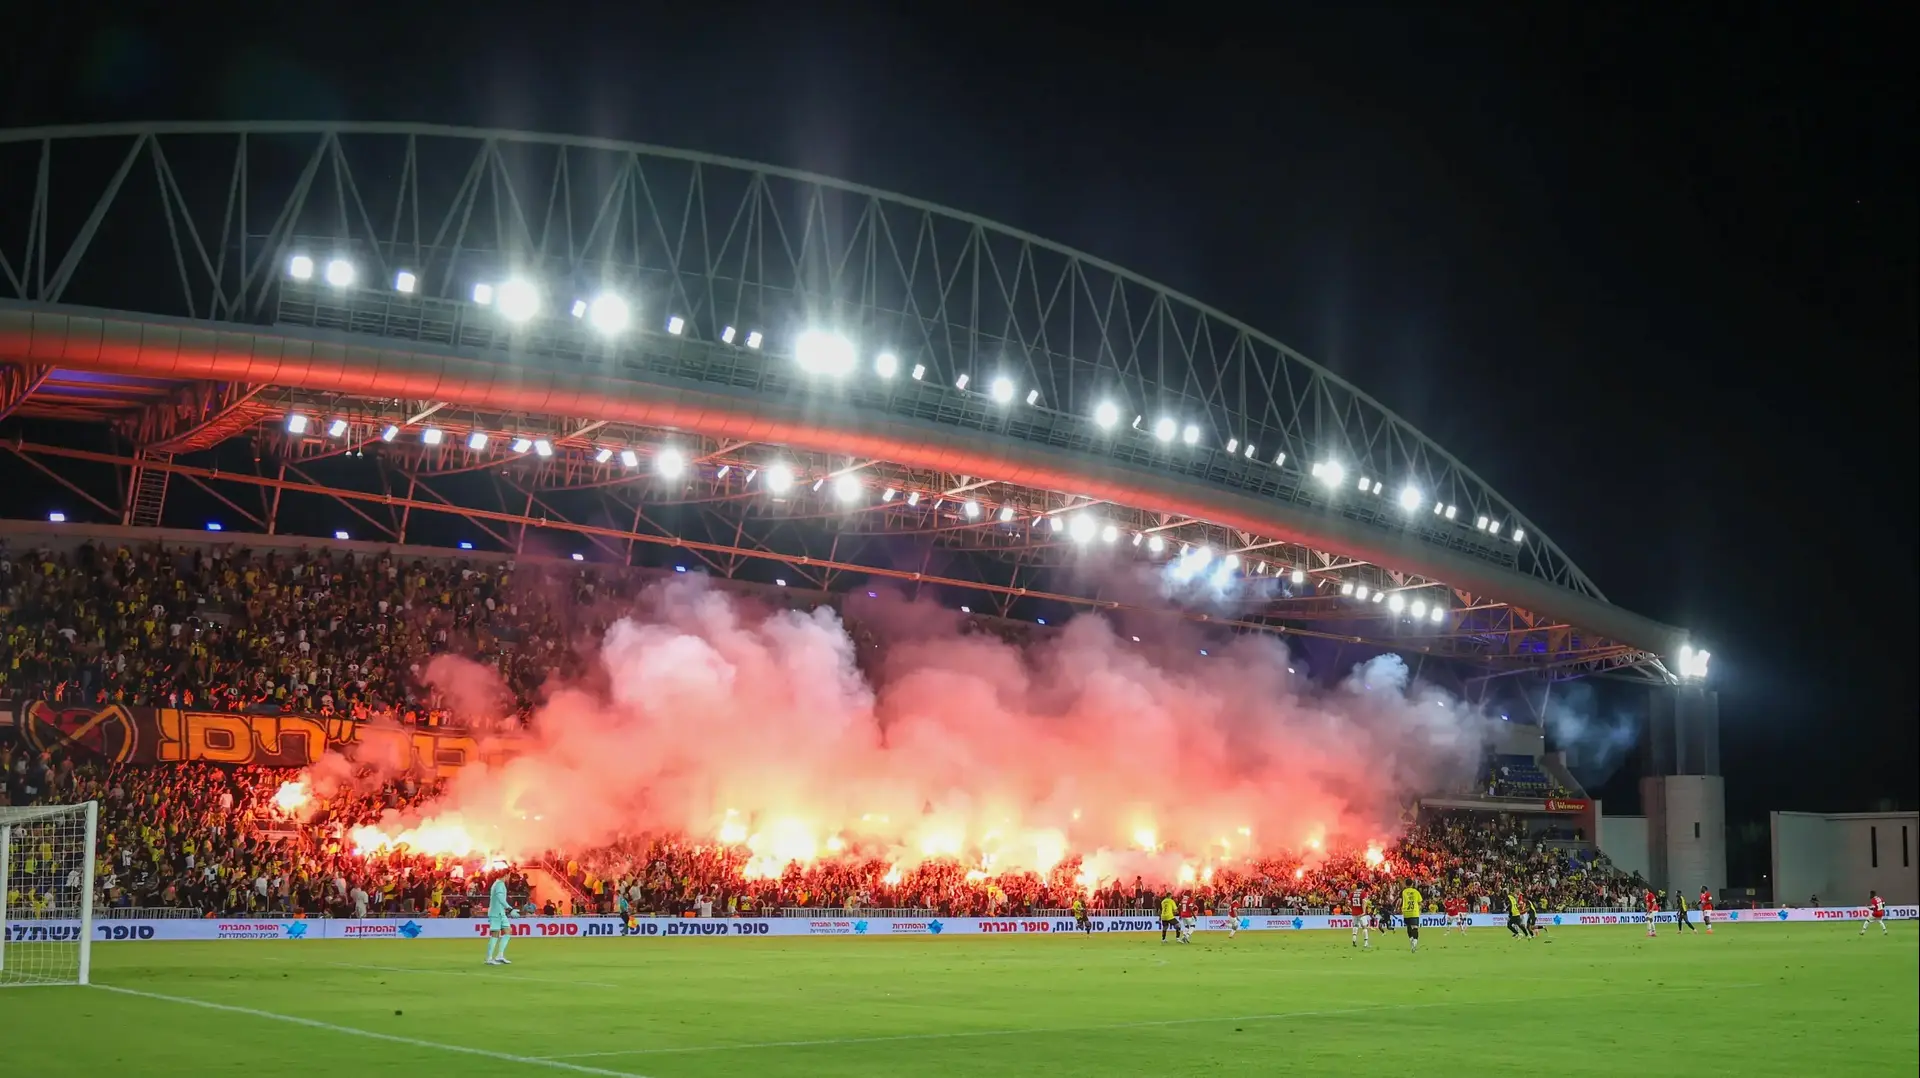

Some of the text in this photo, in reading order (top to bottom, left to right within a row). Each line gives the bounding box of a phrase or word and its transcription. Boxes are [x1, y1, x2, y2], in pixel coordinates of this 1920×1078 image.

[1557, 801, 1584, 810] Winner
[1847, 910, 1869, 918] סופר
[1893, 909, 1917, 917] סופר
[979, 922, 1017, 932] חברתי
[1021, 922, 1049, 932] סופר
[1053, 922, 1074, 933] נוח,
[1107, 920, 1152, 932] משתלם,
[1420, 918, 1447, 927] שתלם,
[98, 926, 154, 940] סופר
[475, 924, 531, 936] חבתי
[536, 923, 578, 935] סופר
[583, 923, 613, 936] נוח,
[663, 922, 728, 936] משתלם,
[733, 923, 769, 934] סופר
